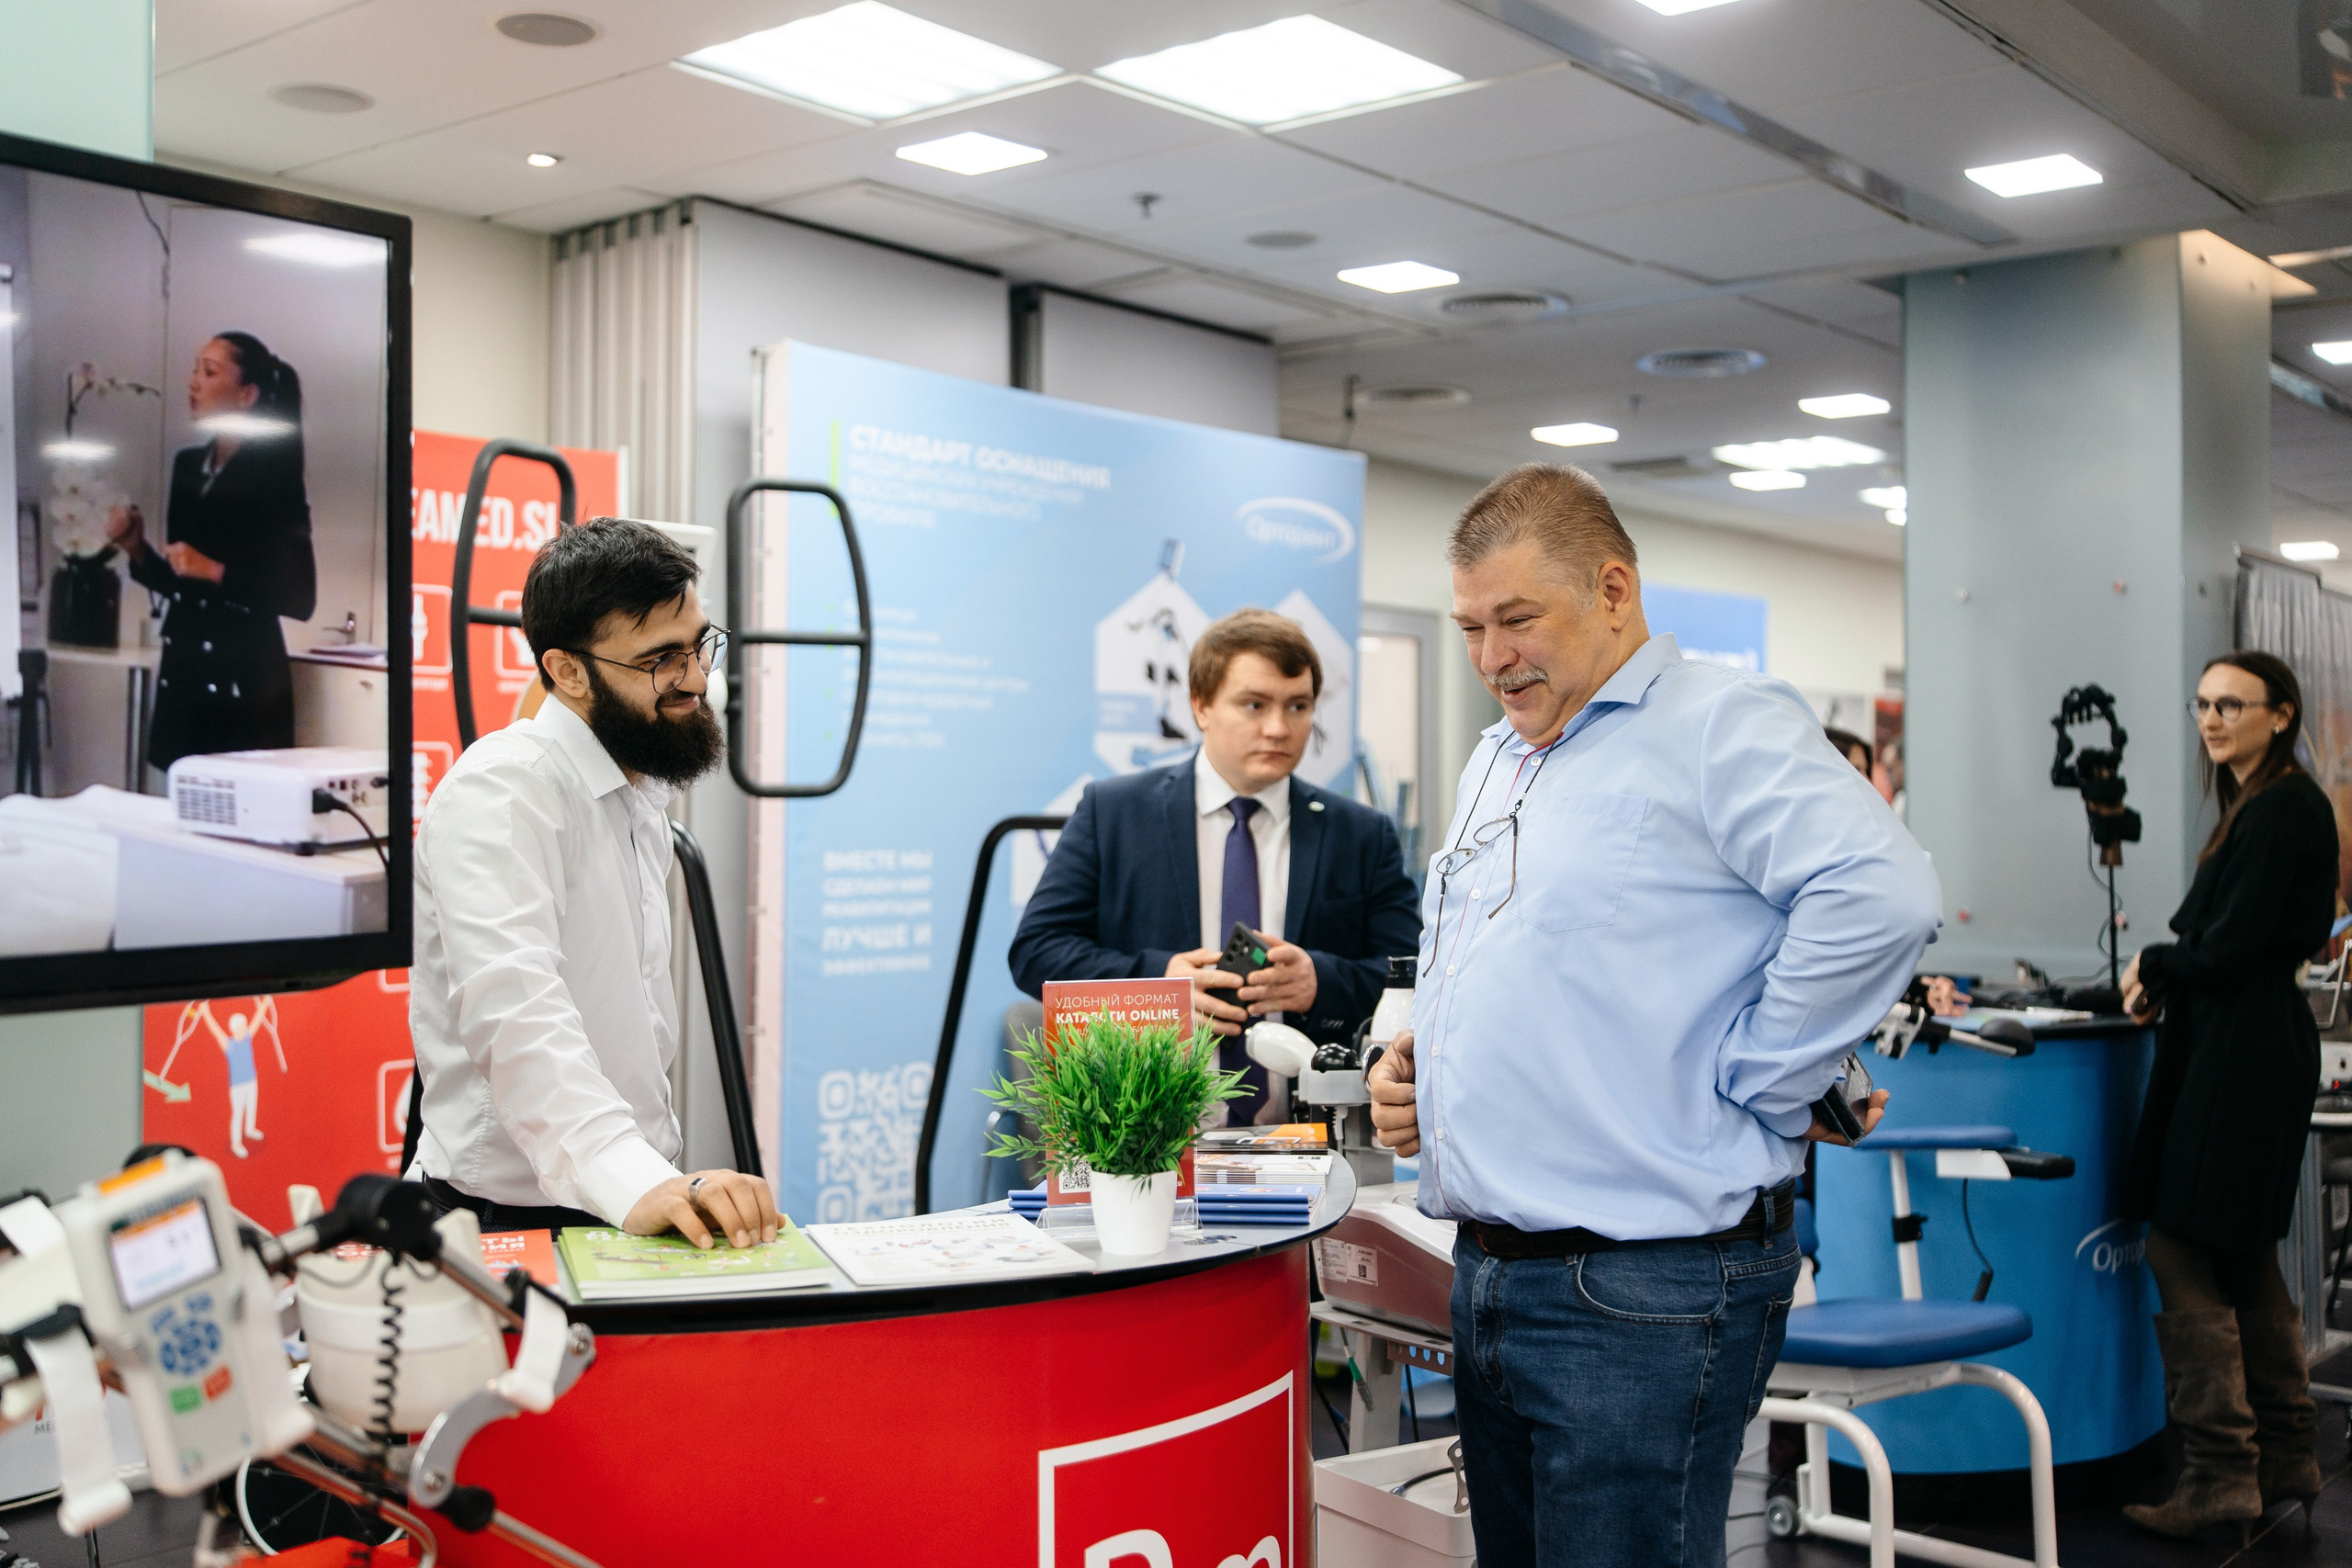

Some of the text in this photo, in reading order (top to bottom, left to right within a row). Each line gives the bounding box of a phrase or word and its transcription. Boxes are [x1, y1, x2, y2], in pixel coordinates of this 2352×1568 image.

[849, 424, 1112, 490] СТАНДАРТ ОСНАЩЕНИЯ
[823, 849, 933, 872] ВМЕСТЕ МЫ
[820, 923, 909, 951] ЛУЧШЕ
[1055, 992, 1179, 1010] УДОБНЫЙ ФОРМАТ
[1130, 1009, 1180, 1021] ONLINE
[832, 1217, 1006, 1232] ТЕХНОЛОГИИ
